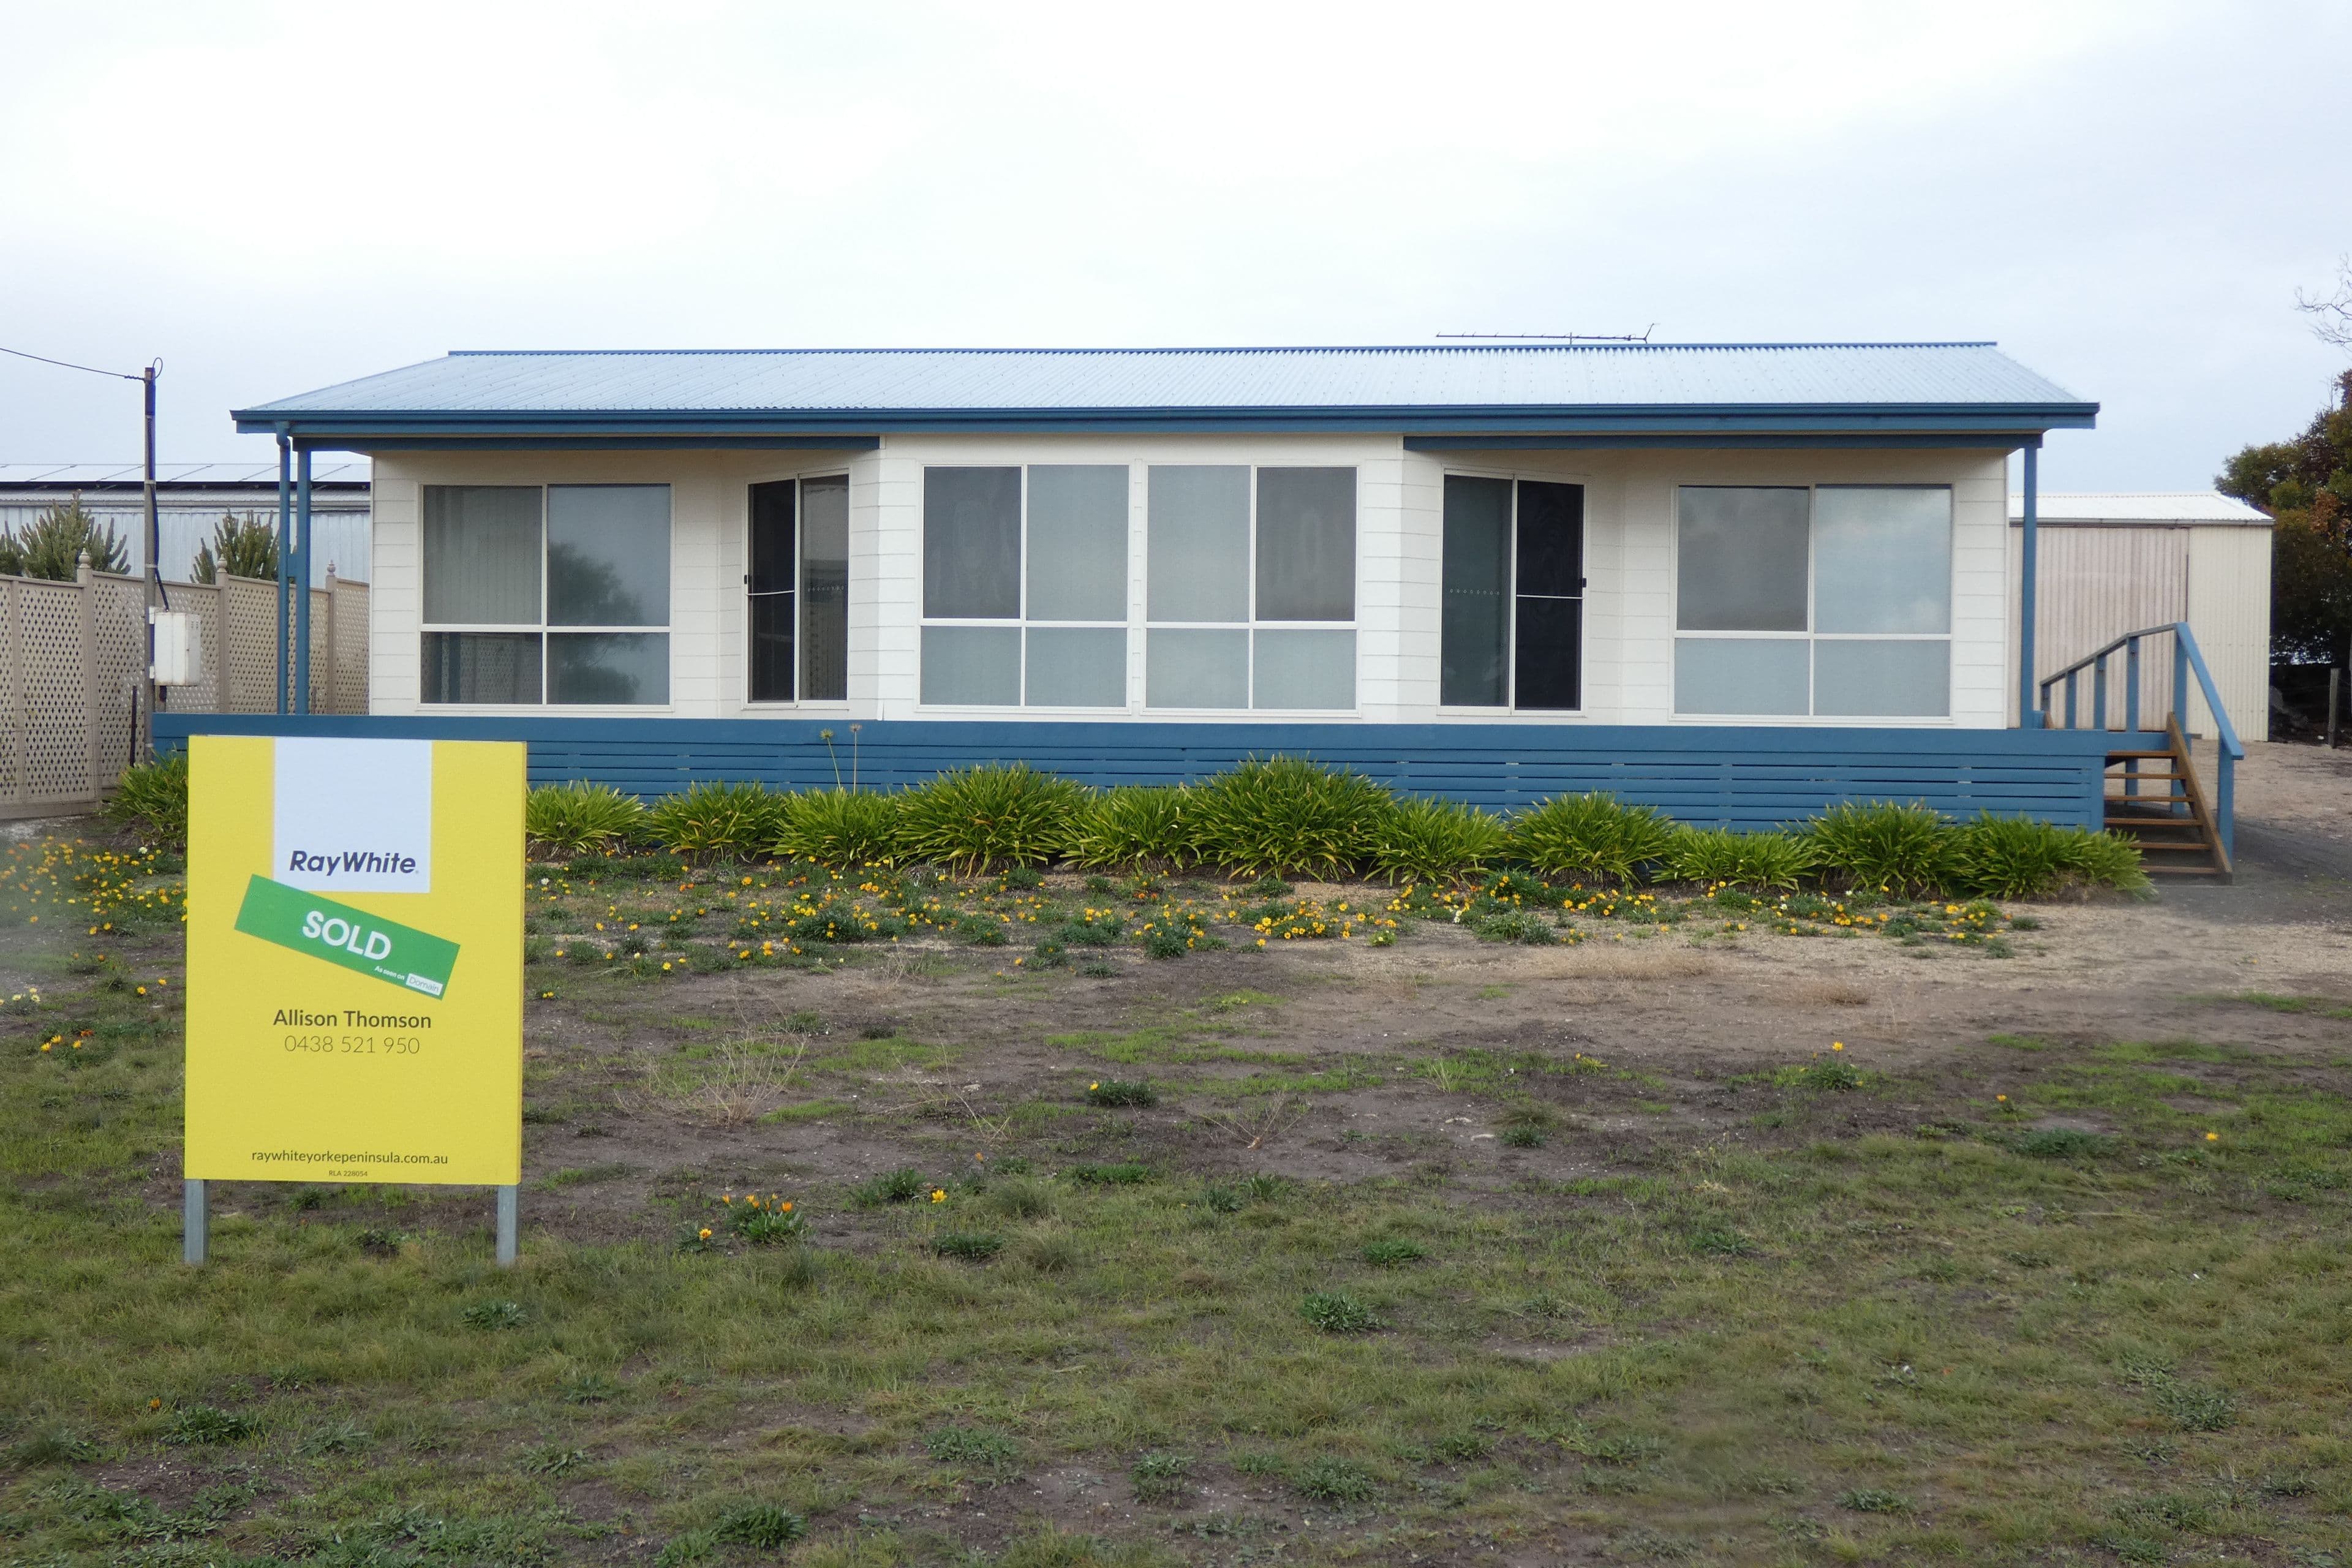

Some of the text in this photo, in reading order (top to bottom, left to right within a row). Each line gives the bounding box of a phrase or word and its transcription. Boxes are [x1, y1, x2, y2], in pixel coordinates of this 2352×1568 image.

[302, 910, 391, 960] SOLD
[383, 969, 397, 978] seen
[409, 976, 440, 992] Domain
[273, 1009, 432, 1028] Allison Thomson
[284, 1035, 420, 1054] 0438 521 950
[252, 1150, 448, 1164] raywhiteyorkepeninsula.com.au
